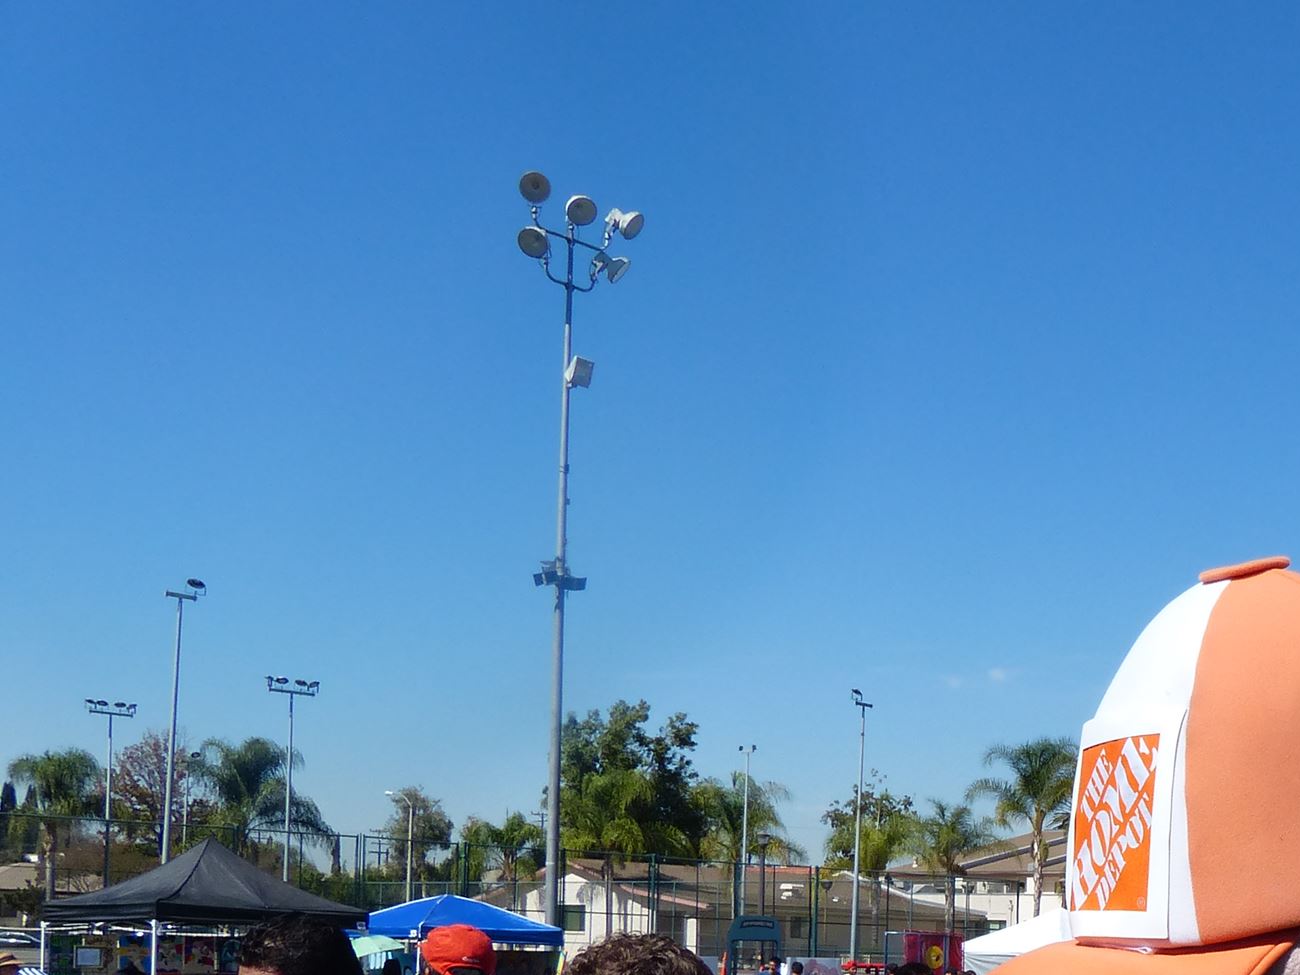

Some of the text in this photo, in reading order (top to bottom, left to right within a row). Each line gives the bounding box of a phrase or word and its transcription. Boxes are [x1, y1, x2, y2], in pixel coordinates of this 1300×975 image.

[1072, 737, 1158, 911] HOME
[1081, 749, 1113, 822] THE
[1094, 792, 1152, 911] DEPOT
